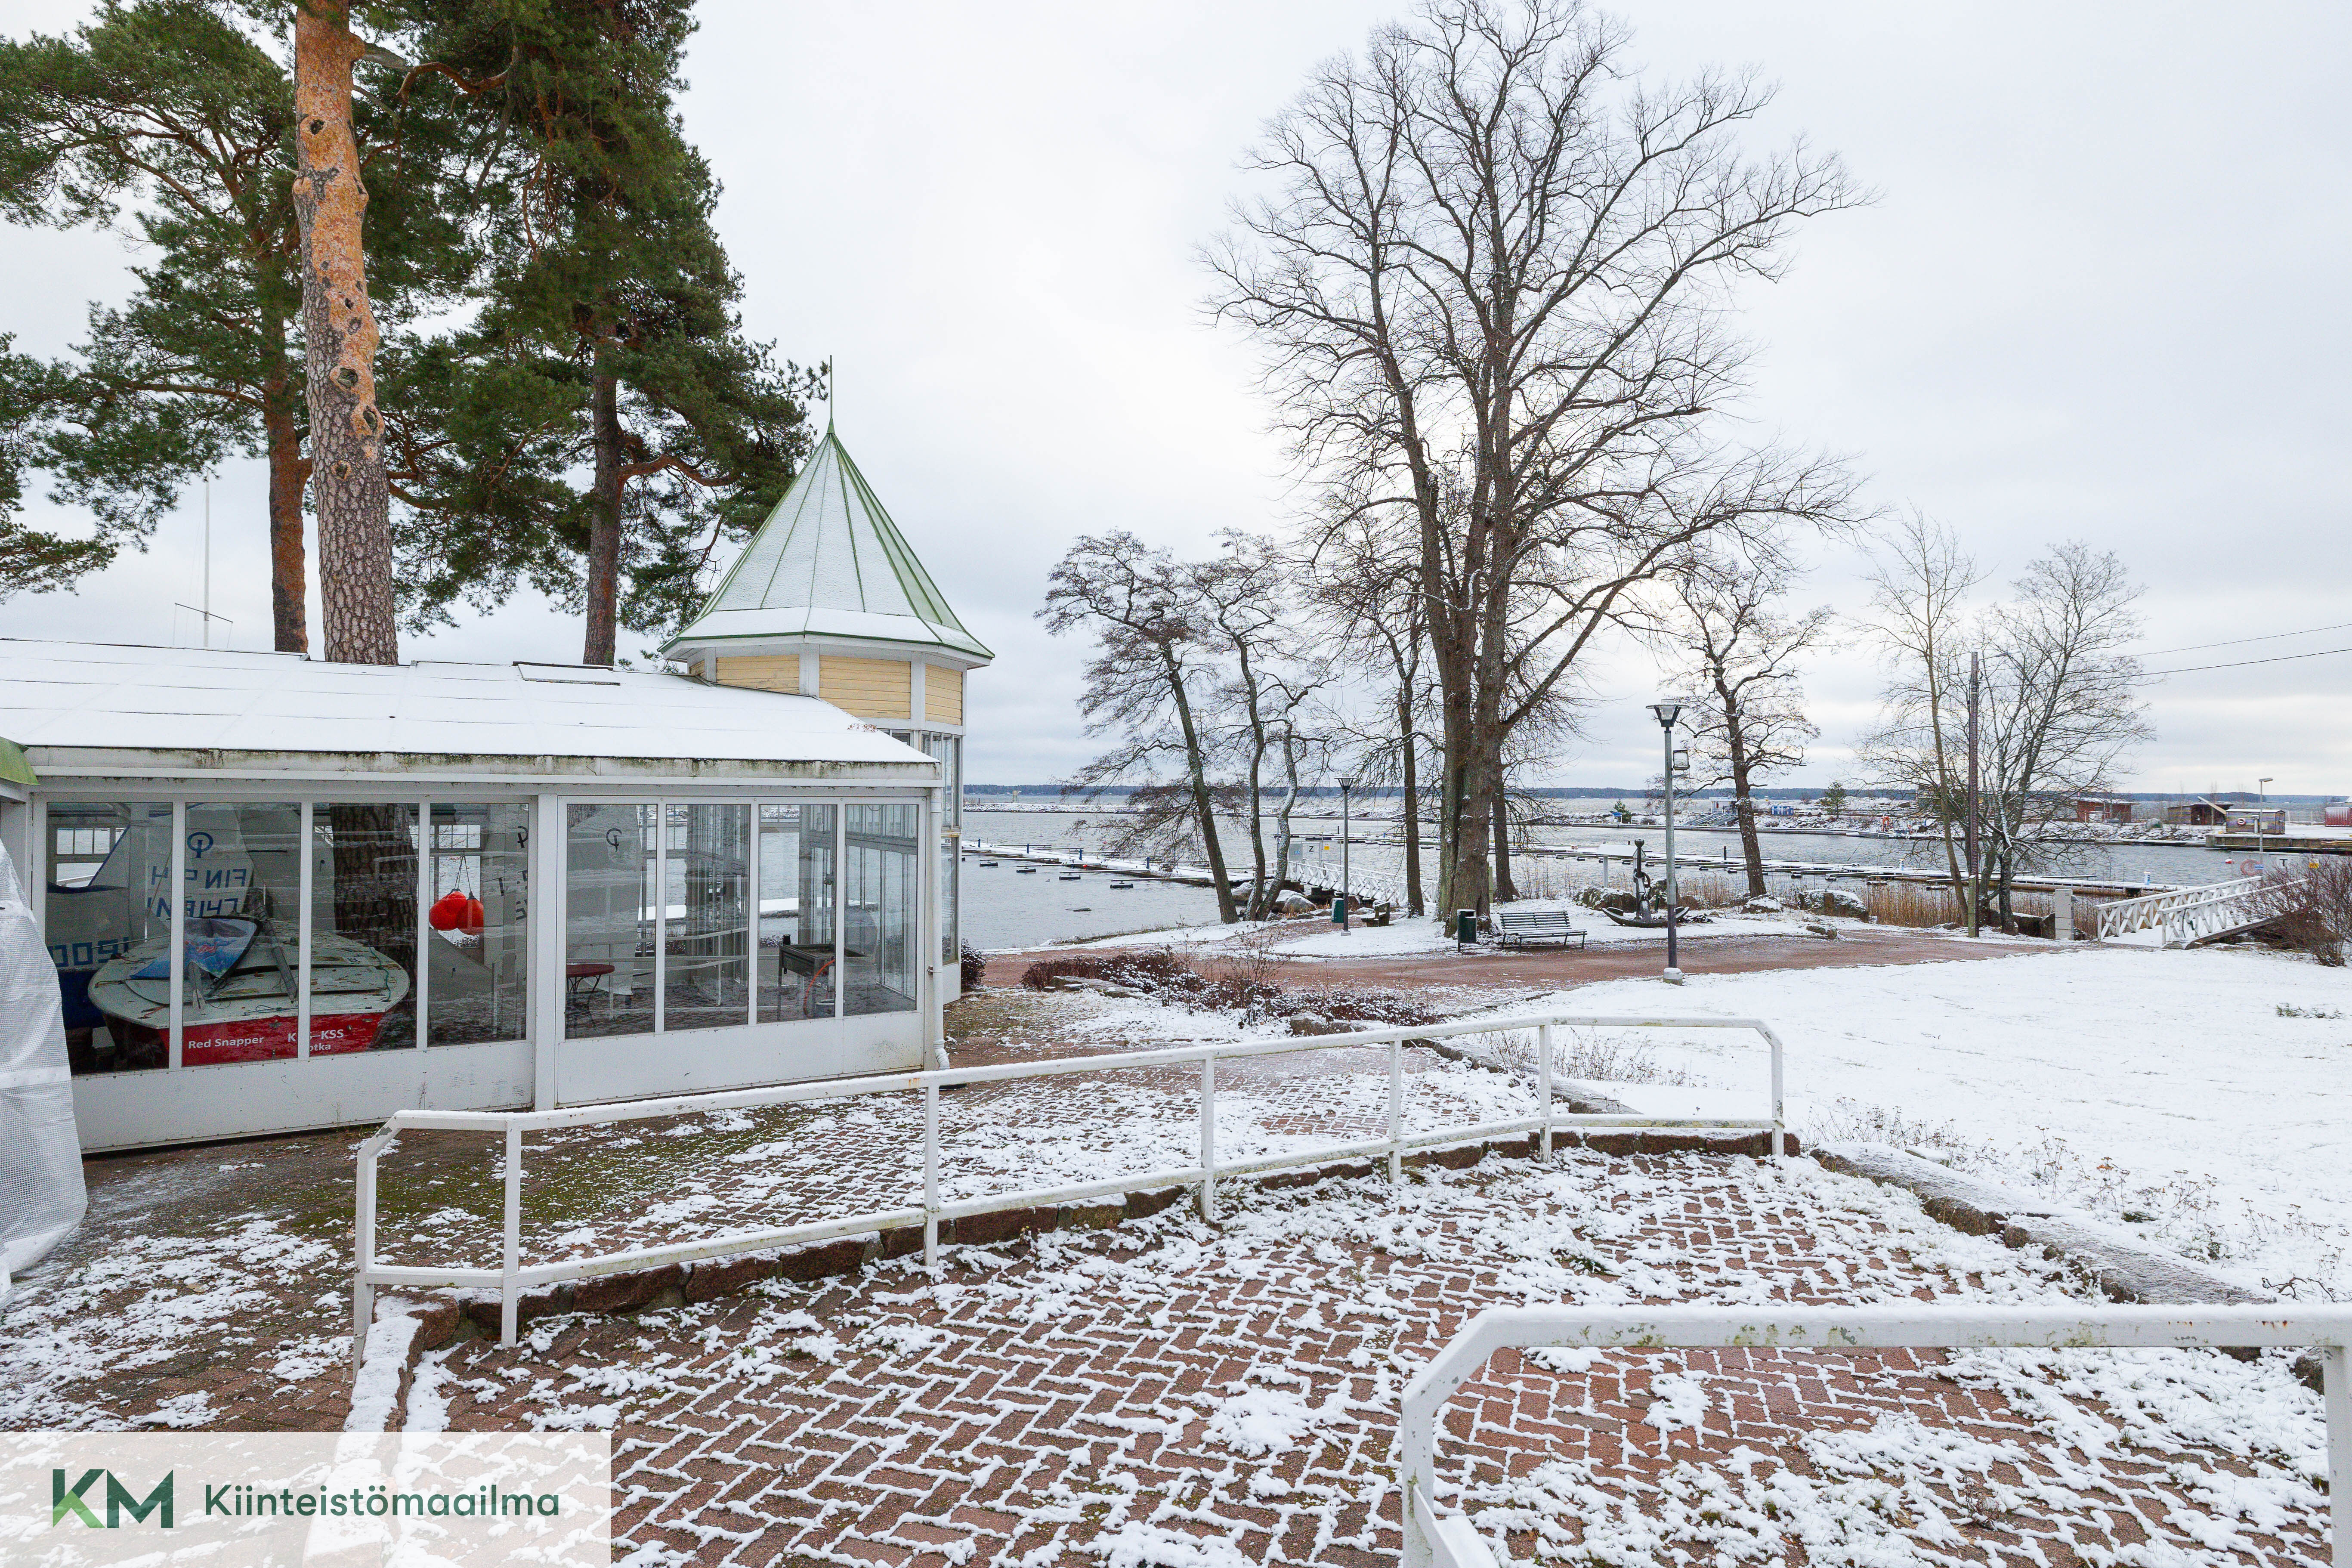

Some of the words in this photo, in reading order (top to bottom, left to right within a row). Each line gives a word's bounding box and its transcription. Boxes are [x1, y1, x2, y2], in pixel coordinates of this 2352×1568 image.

[189, 1039, 211, 1049] Red
[214, 1036, 264, 1047] Snapper
[309, 1042, 331, 1051] otka
